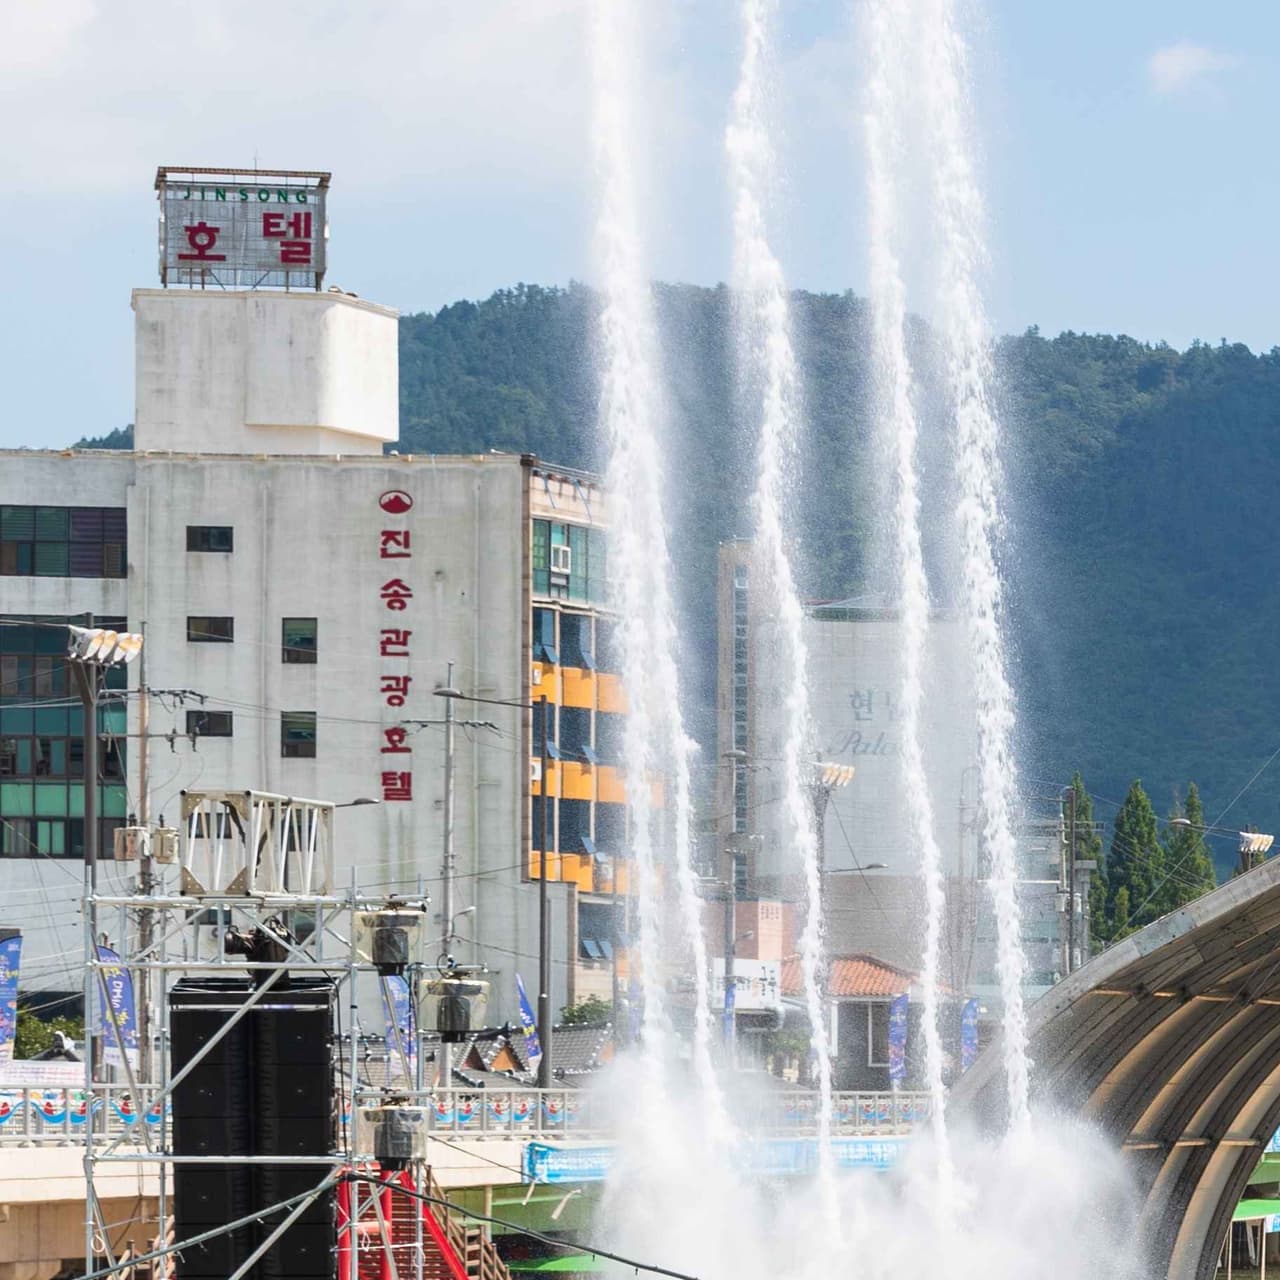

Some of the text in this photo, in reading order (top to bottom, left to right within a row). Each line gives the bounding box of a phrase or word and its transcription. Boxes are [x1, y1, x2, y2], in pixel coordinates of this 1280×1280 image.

[183, 187, 308, 203] JINSONG
[177, 211, 312, 264] 호텔
[378, 529, 413, 802] 진송관광호텔
